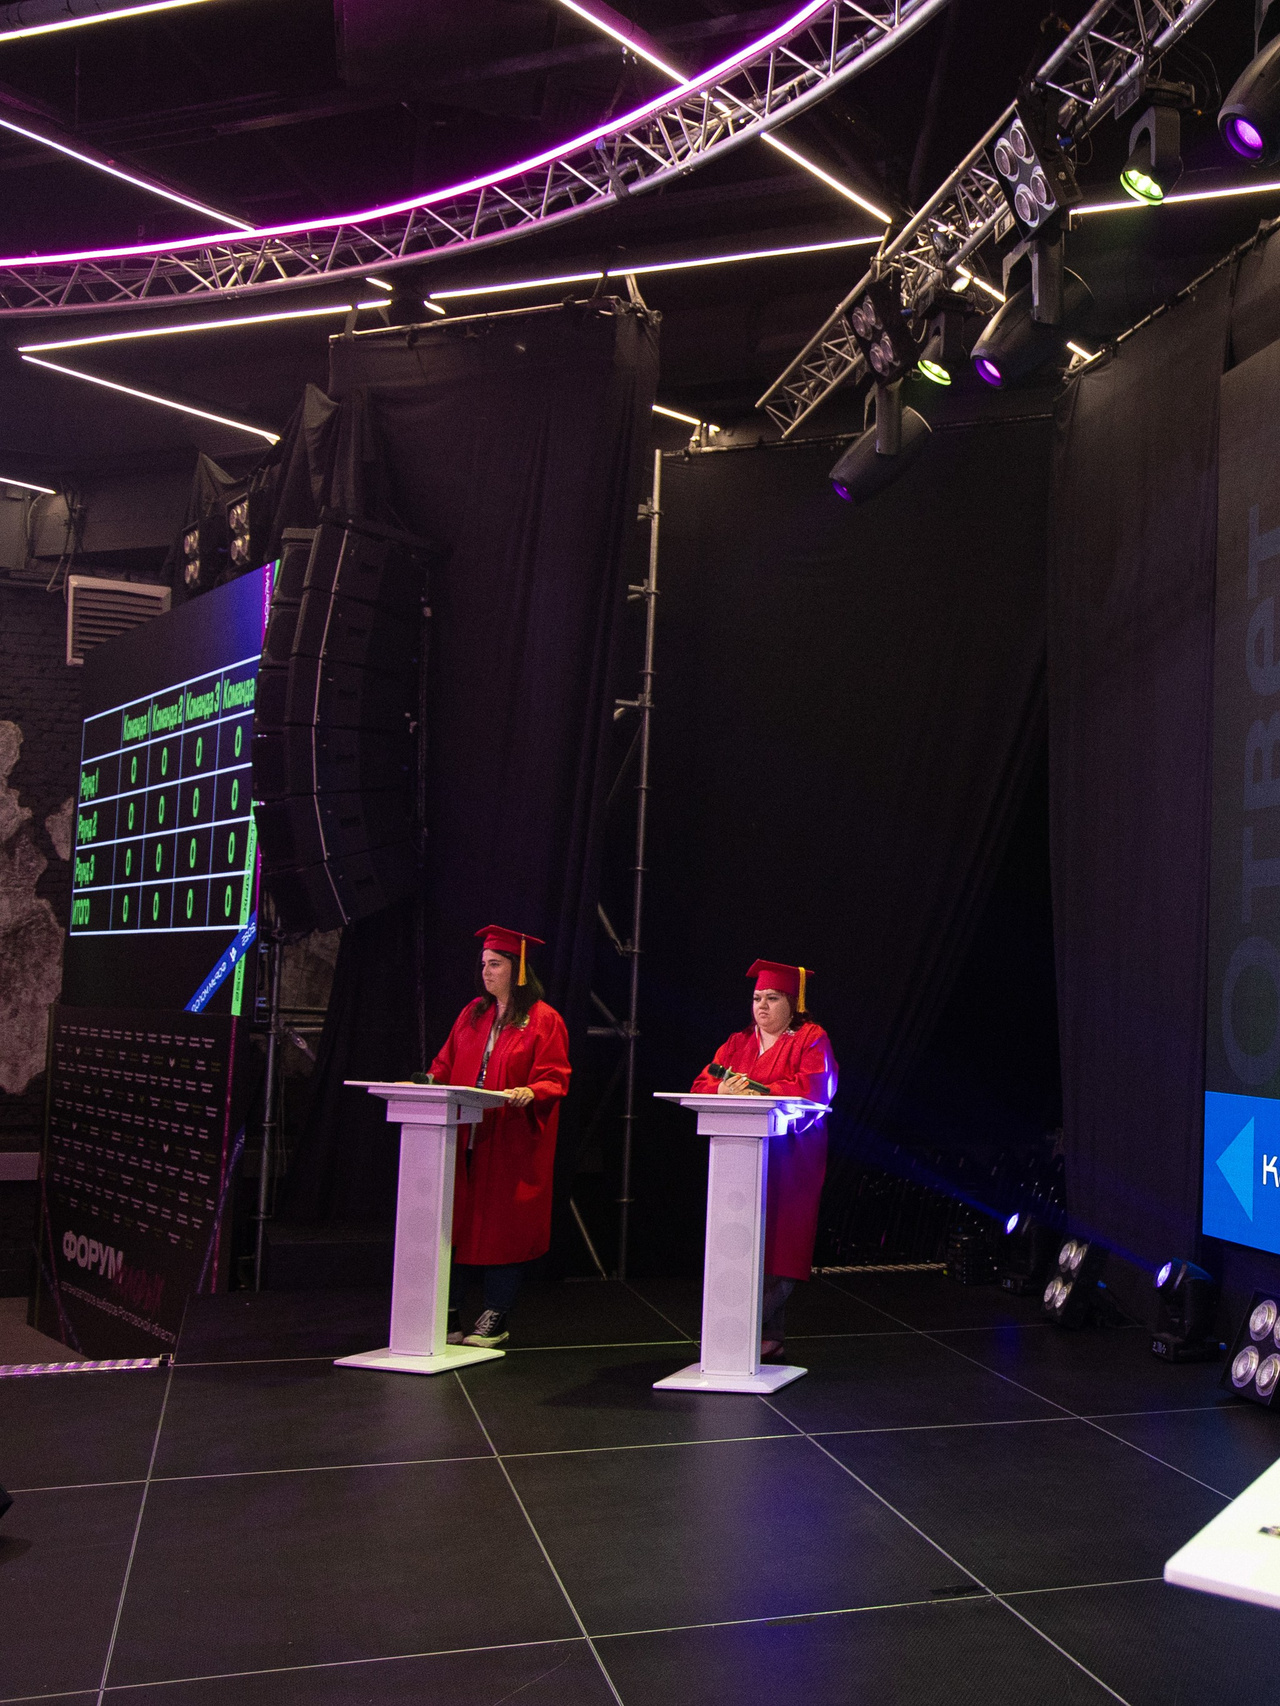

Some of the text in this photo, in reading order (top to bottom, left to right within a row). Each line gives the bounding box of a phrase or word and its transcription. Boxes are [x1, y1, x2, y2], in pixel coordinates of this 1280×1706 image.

[122, 713, 147, 741] Команда
[152, 703, 178, 732] Команда
[186, 691, 215, 721] Команда
[215, 681, 221, 713] 3
[223, 677, 256, 709] Команда
[130, 756, 138, 783] 0
[161, 747, 168, 776] 0
[195, 737, 203, 767] 0
[234, 726, 243, 758] 0
[128, 802, 135, 830] 0
[158, 795, 165, 825] 0
[192, 787, 200, 818] 0
[231, 779, 239, 811] 0
[89, 854, 95, 881] 3
[125, 849, 132, 876] 0
[155, 843, 162, 873] 0
[189, 837, 197, 868] 0
[227, 831, 236, 864] 0
[122, 894, 129, 923] 0
[152, 891, 160, 921] 0
[186, 888, 194, 919] 0
[224, 884, 232, 918] 0
[63, 1230, 123, 1284] ФОРУМ
